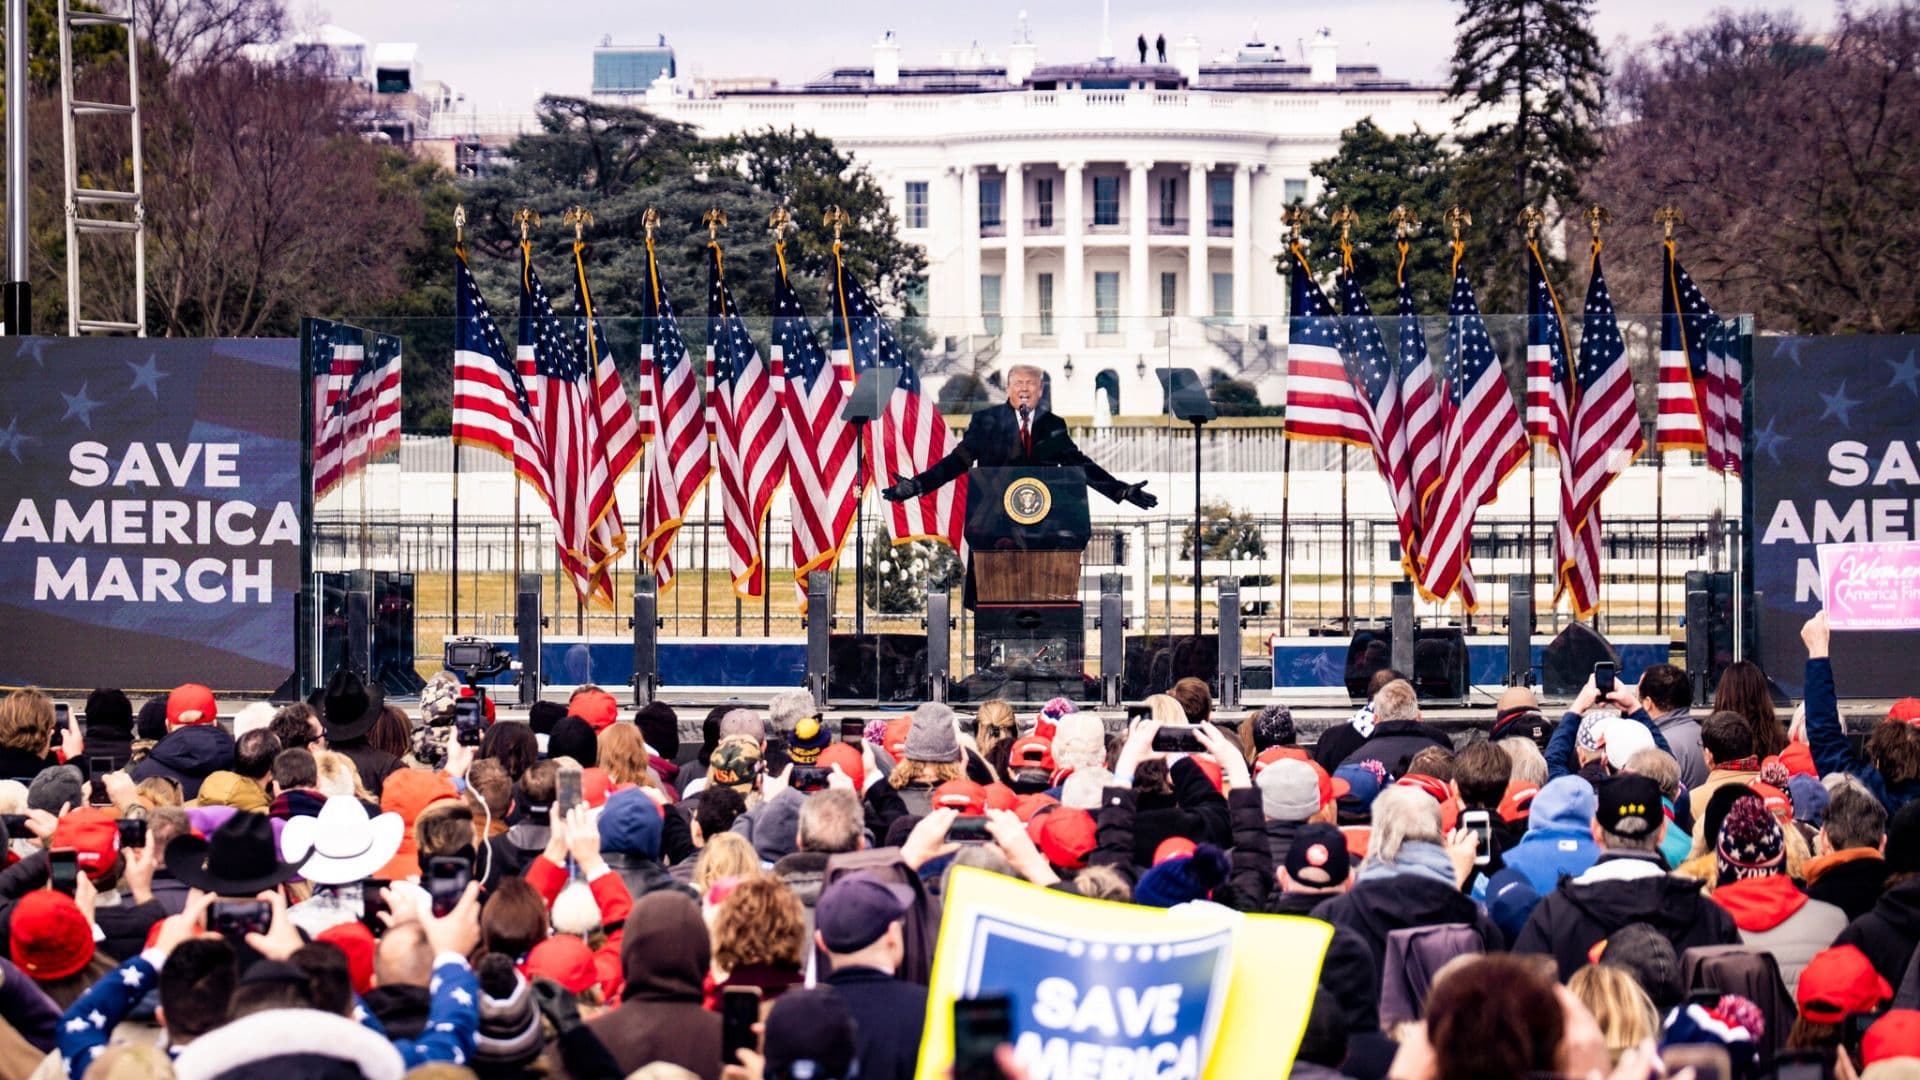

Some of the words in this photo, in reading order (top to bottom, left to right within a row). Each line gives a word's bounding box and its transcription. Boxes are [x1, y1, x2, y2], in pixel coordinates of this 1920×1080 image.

[69, 441, 241, 487] SAVE
[1827, 440, 1920, 487] SA
[2, 498, 301, 546] AMERICA
[1761, 498, 1920, 544] AME
[34, 556, 273, 603] MARCH
[1031, 976, 1183, 1038] SAVE
[1013, 1030, 1199, 1080] MERICA
